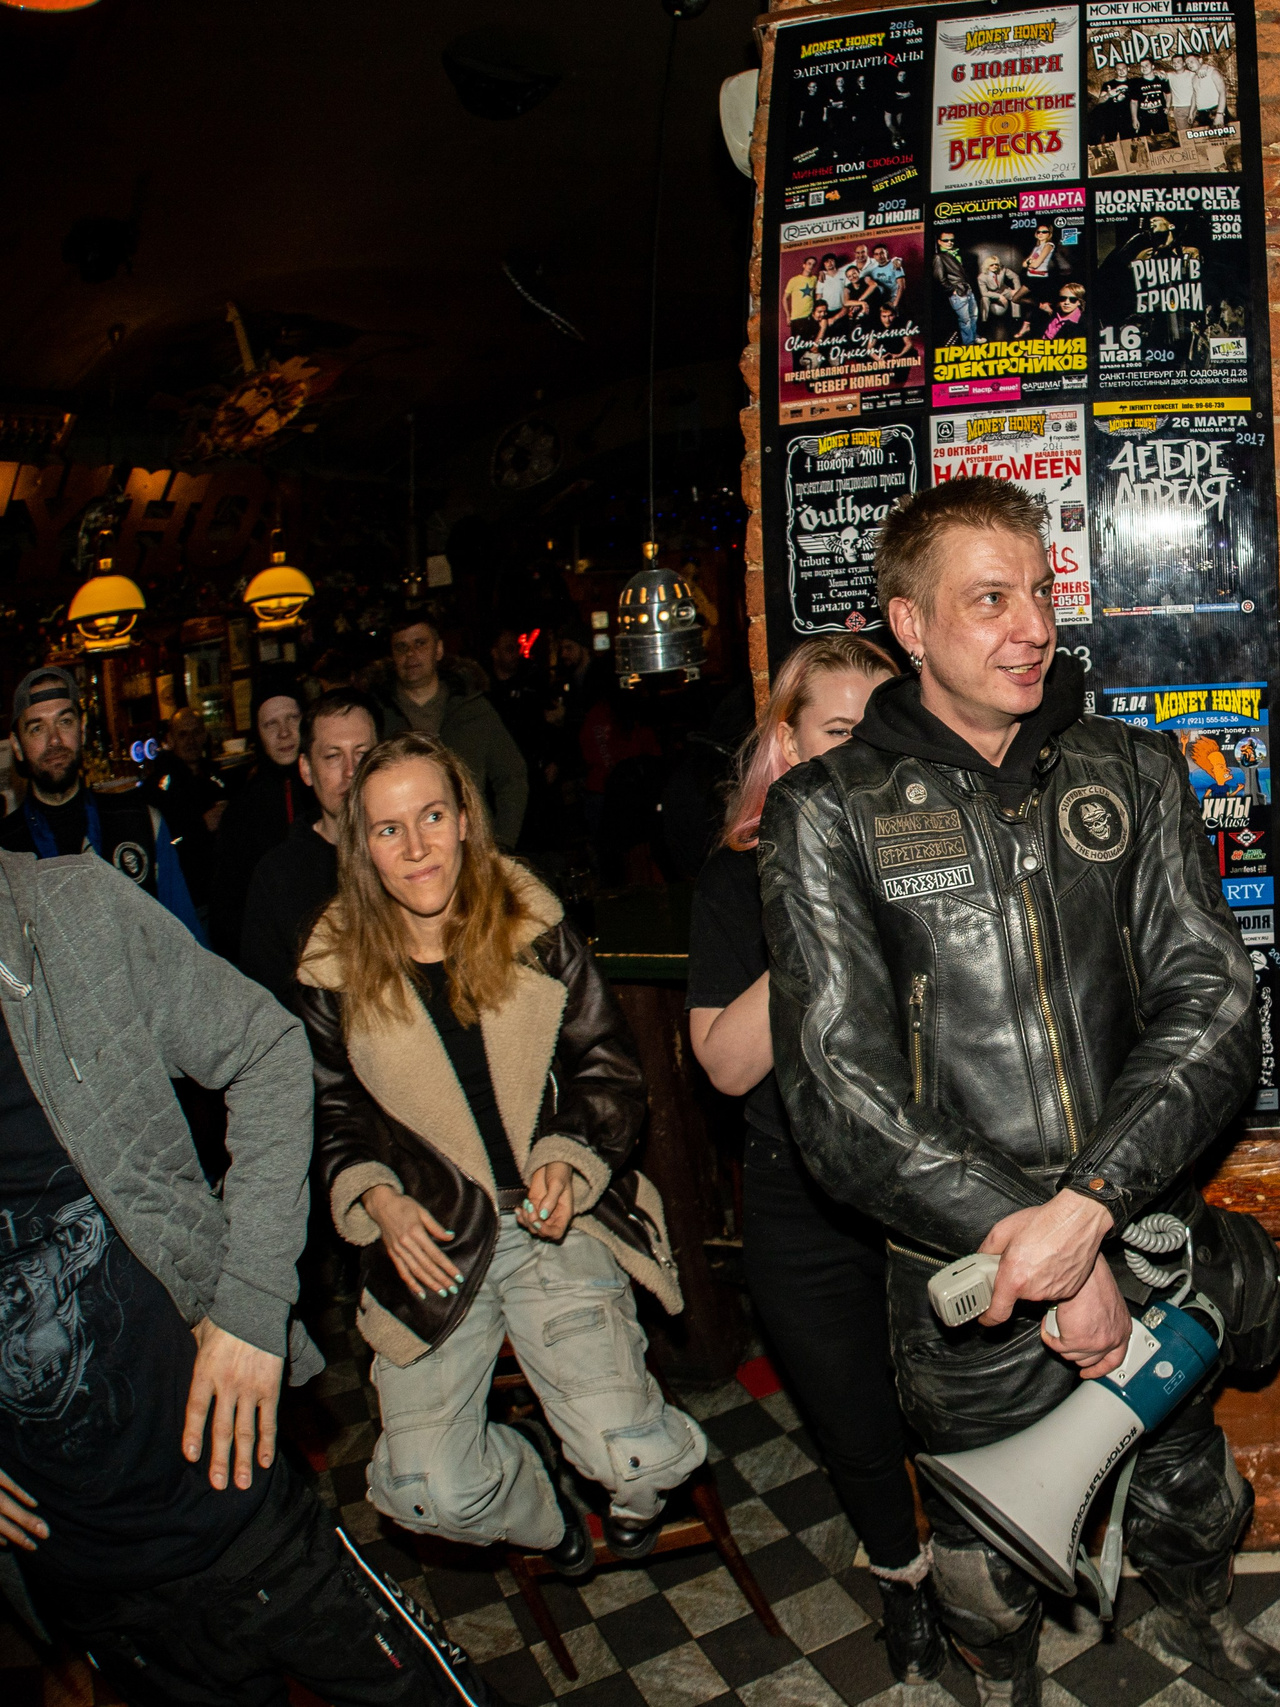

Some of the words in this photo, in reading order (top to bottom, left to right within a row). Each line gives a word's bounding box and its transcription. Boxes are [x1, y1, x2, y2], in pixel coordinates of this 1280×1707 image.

[1090, 2, 1129, 16] MONEY
[1132, 0, 1170, 14] HONEY
[1176, 2, 1183, 13] 1
[1185, 1, 1230, 13] АВГУСТА
[890, 30, 901, 39] 13
[903, 27, 923, 37] МАЯ
[966, 27, 1011, 52] MONEY
[1013, 21, 1056, 43] HONEY
[1090, 31, 1120, 44] группа
[801, 38, 843, 58] MONEY
[845, 32, 886, 47] HONEY
[951, 63, 966, 83] 6
[970, 53, 1063, 81] НОЯБРЯ
[987, 86, 1025, 97] группы
[936, 92, 1076, 126] РАВНОДЕНСТВИЕ
[1187, 126, 1236, 140] Волгоград
[948, 128, 1063, 171] ВЕРЕСКЪ
[792, 166, 834, 180] МИННЫЕ
[836, 160, 865, 174] ПОЛЯ
[866, 154, 914, 168] СВОБОДЫ
[1051, 162, 1077, 173] 2017
[944, 182, 968, 190] начало
[996, 177, 1012, 185] цена
[1013, 174, 1037, 182] билета
[1038, 173, 1051, 181] 250
[1051, 172, 1067, 181] руб.
[1021, 196, 1036, 209] 28
[1039, 191, 1084, 207] МАРТА
[1095, 186, 1240, 205] MONEY-HONEY
[935, 199, 1018, 219] REVOLUTION
[1095, 200, 1194, 215] ROCK'N'ROLL
[1202, 199, 1241, 210] CLUB
[868, 214, 883, 227] 20
[885, 208, 920, 225] ИЮЛЯ
[1010, 218, 1037, 230] 2009
[1211, 214, 1242, 223] ВХОД
[784, 218, 860, 242] REVOLUTION
[1212, 222, 1241, 233] 300
[1212, 232, 1242, 241] рублей
[1131, 257, 1182, 291] РУКИ
[1189, 258, 1201, 280] В
[1136, 282, 1204, 313] БРЮКИ
[785, 335, 847, 352] Светлана
[851, 320, 920, 346] Сурганова
[1099, 325, 1141, 350] 16
[829, 344, 887, 364] Оркестр
[934, 337, 1087, 364] ПРИКЛЮЧЕНИЯ
[1100, 349, 1142, 363] мая
[1145, 349, 1175, 362] 2010
[785, 365, 849, 382] ПРЕДСТАВЛЯЮТ
[850, 361, 886, 372] АЛЬБОМ
[886, 357, 922, 369] ГРУППЫ
[933, 354, 1088, 382] ЭЛЕКТРОНИКОВ
[1100, 371, 1174, 381] САНКТ-ПЕТЕРБУРГ
[1175, 370, 1189, 378] УЛ.
[1190, 369, 1228, 378] САДОВАЯ
[1230, 368, 1247, 377] Д.28
[1131, 379, 1170, 387] ГОСТИННЫЙ
[967, 417, 1006, 442] MONEY
[1008, 414, 1046, 437] HONEY
[1109, 419, 1133, 432] MONEY
[1134, 417, 1157, 430] HONEY
[1172, 417, 1190, 428] 26
[1194, 416, 1248, 427] МАРТА
[818, 433, 850, 455] MONEY
[851, 430, 882, 448] HONEY
[1236, 432, 1265, 447] 2017
[933, 448, 945, 458] 29
[947, 444, 988, 457] ОКТЯБРЯ
[966, 455, 1003, 463] PSYCHOBILLY
[804, 456, 812, 473] 4
[859, 448, 884, 467] 2010
[888, 452, 898, 464] г.
[933, 454, 1081, 486] HALLOWEEN
[879, 472, 906, 492] проекта
[1114, 472, 1235, 522] АПРЕЛЯ
[799, 556, 830, 568] tribute
[834, 555, 844, 564] to
[812, 592, 826, 602] ул.
[829, 588, 870, 599] Садовая,
[812, 602, 852, 613] начало
[856, 601, 865, 610] в
[1112, 696, 1147, 712] 15.04
[1155, 690, 1208, 724] MONEY
[1212, 689, 1262, 720] HONEY
[1187, 717, 1204, 725] (921)
[1206, 716, 1239, 724] 555-55-36
[1224, 734, 1231, 743] 2
[1061, 789, 1087, 812] SUPPORT
[1088, 787, 1110, 798] CLUB
[1202, 797, 1252, 820] ХИТЫ
[1205, 813, 1250, 829] Music
[1074, 842, 1089, 858] THE
